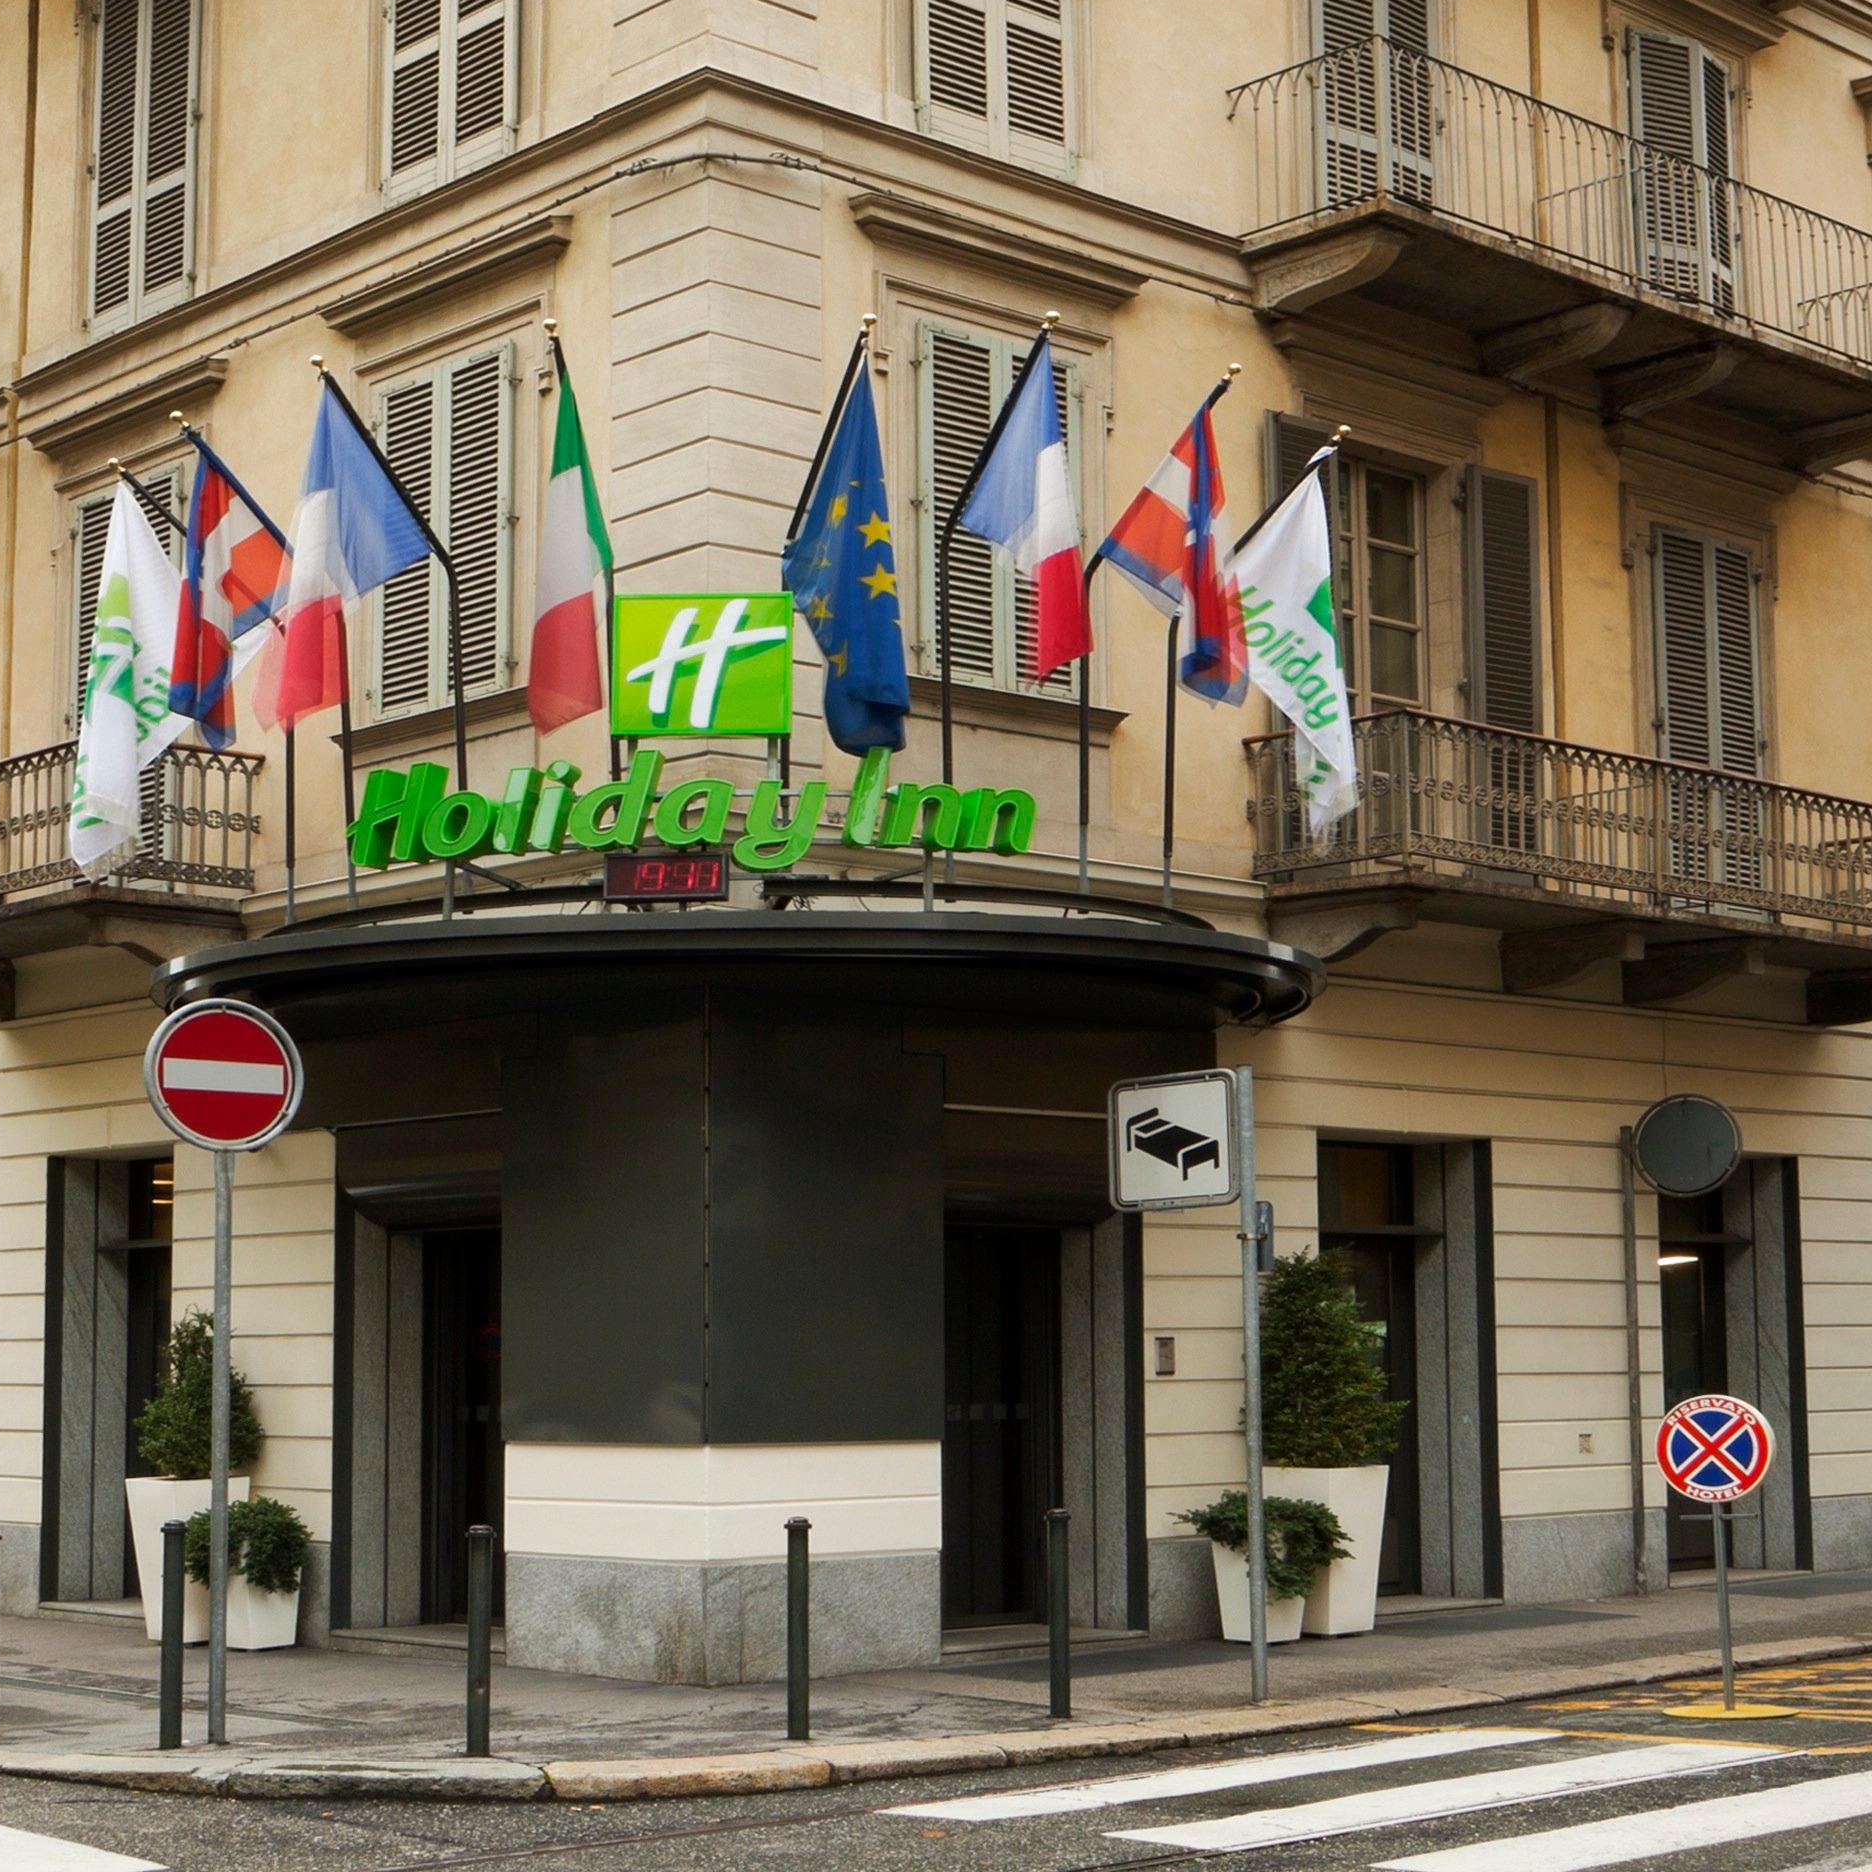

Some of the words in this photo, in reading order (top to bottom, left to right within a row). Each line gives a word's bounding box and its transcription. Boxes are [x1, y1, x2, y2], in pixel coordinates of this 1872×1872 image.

[1236, 584, 1340, 731] Holiday
[345, 749, 831, 872] Holiday
[841, 745, 1037, 856] Inn
[1666, 1398, 1757, 1426] RISERVATO
[1685, 1486, 1744, 1500] HOTEL
